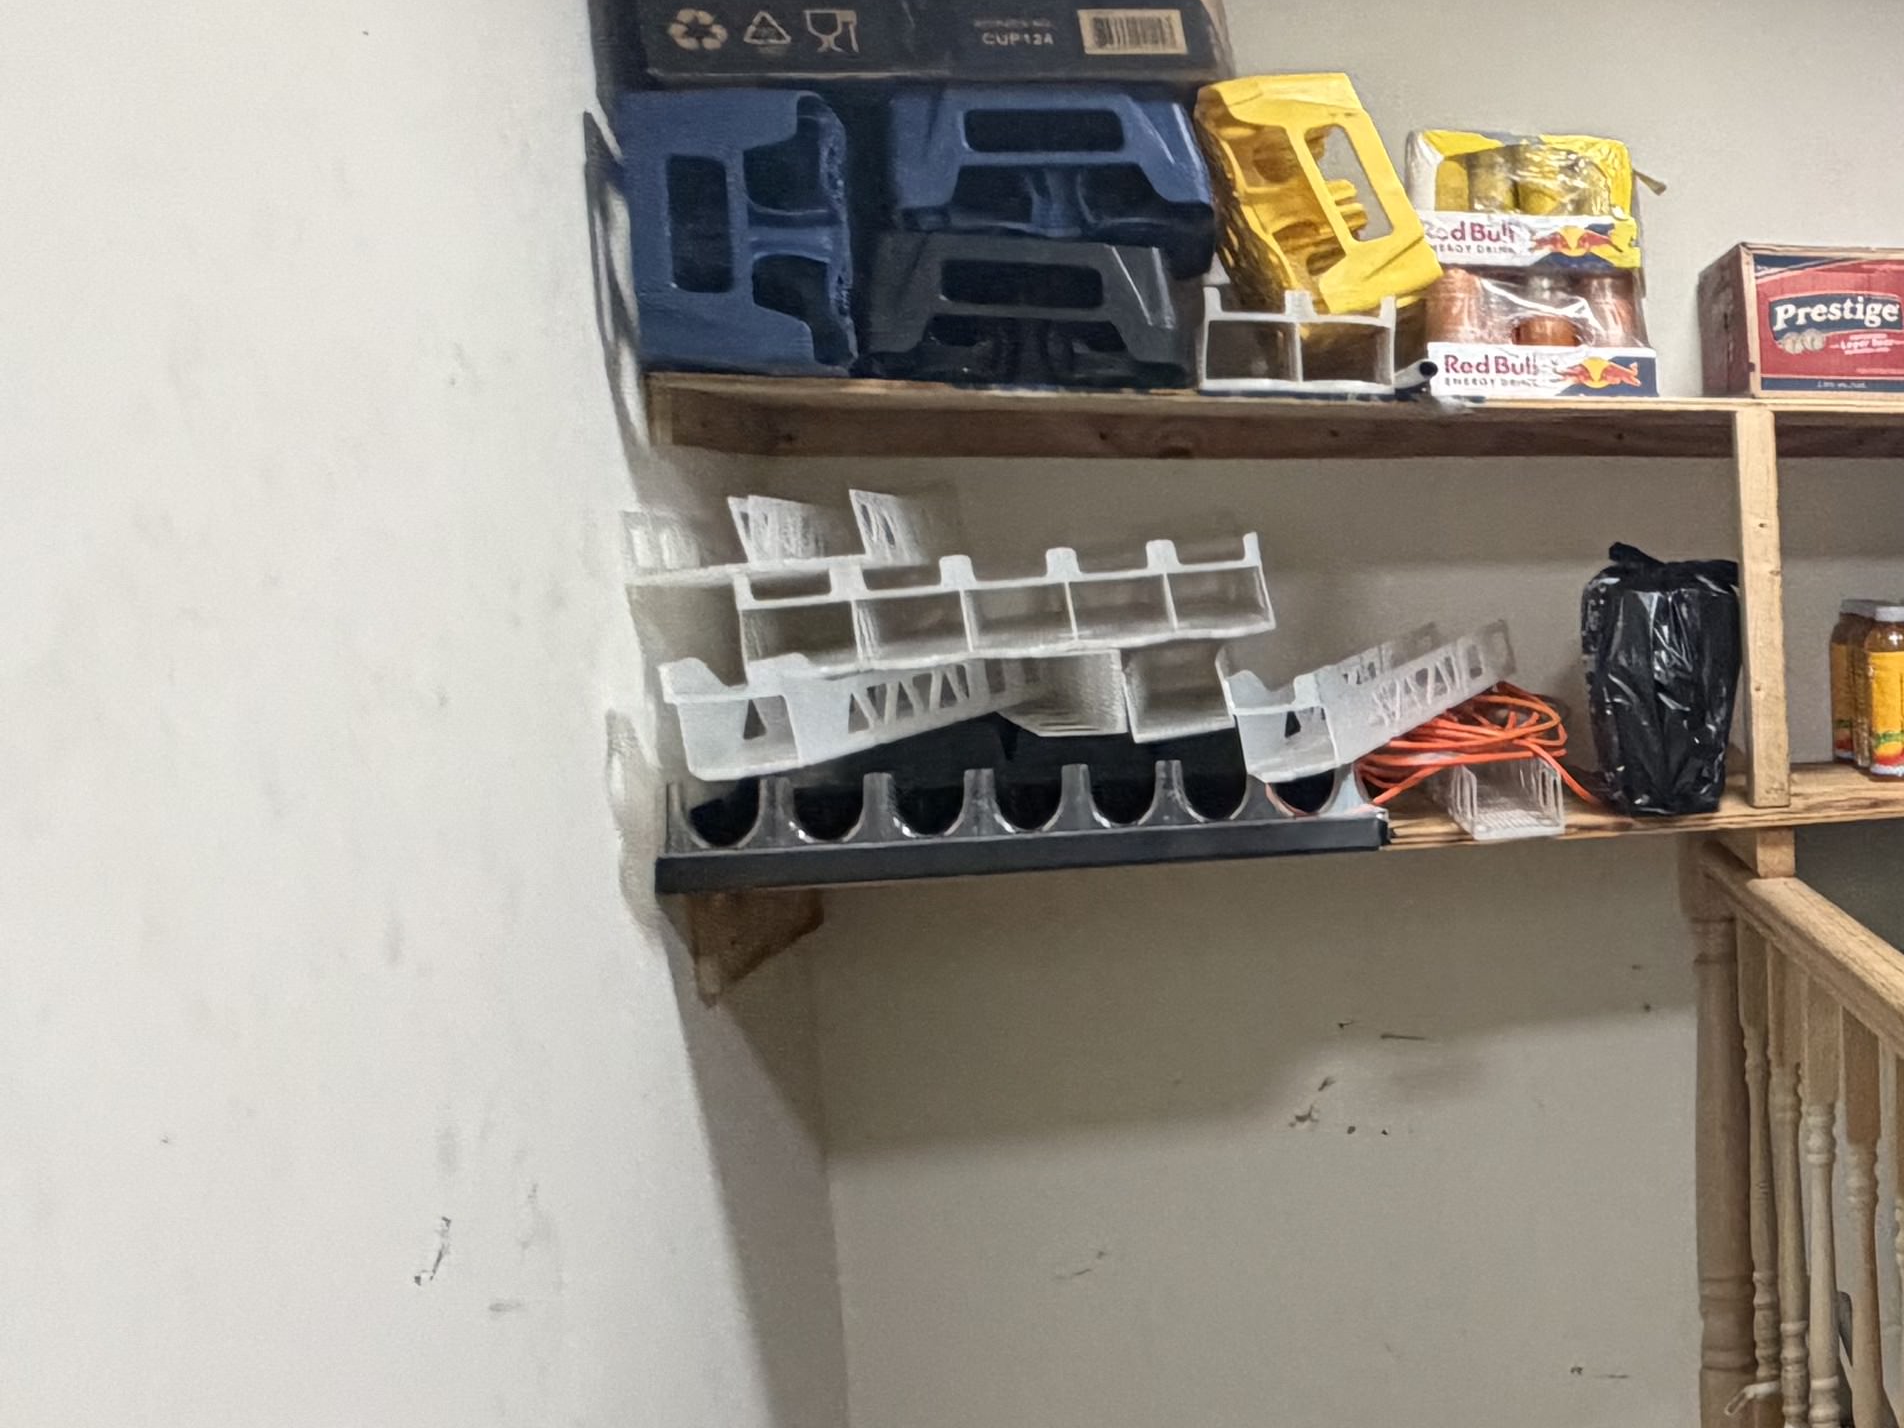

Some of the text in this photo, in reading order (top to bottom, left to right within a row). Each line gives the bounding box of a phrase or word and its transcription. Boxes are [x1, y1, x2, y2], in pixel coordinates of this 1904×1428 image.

[1772, 297, 1900, 331] Prestige
[1444, 354, 1538, 374] Red Bull
